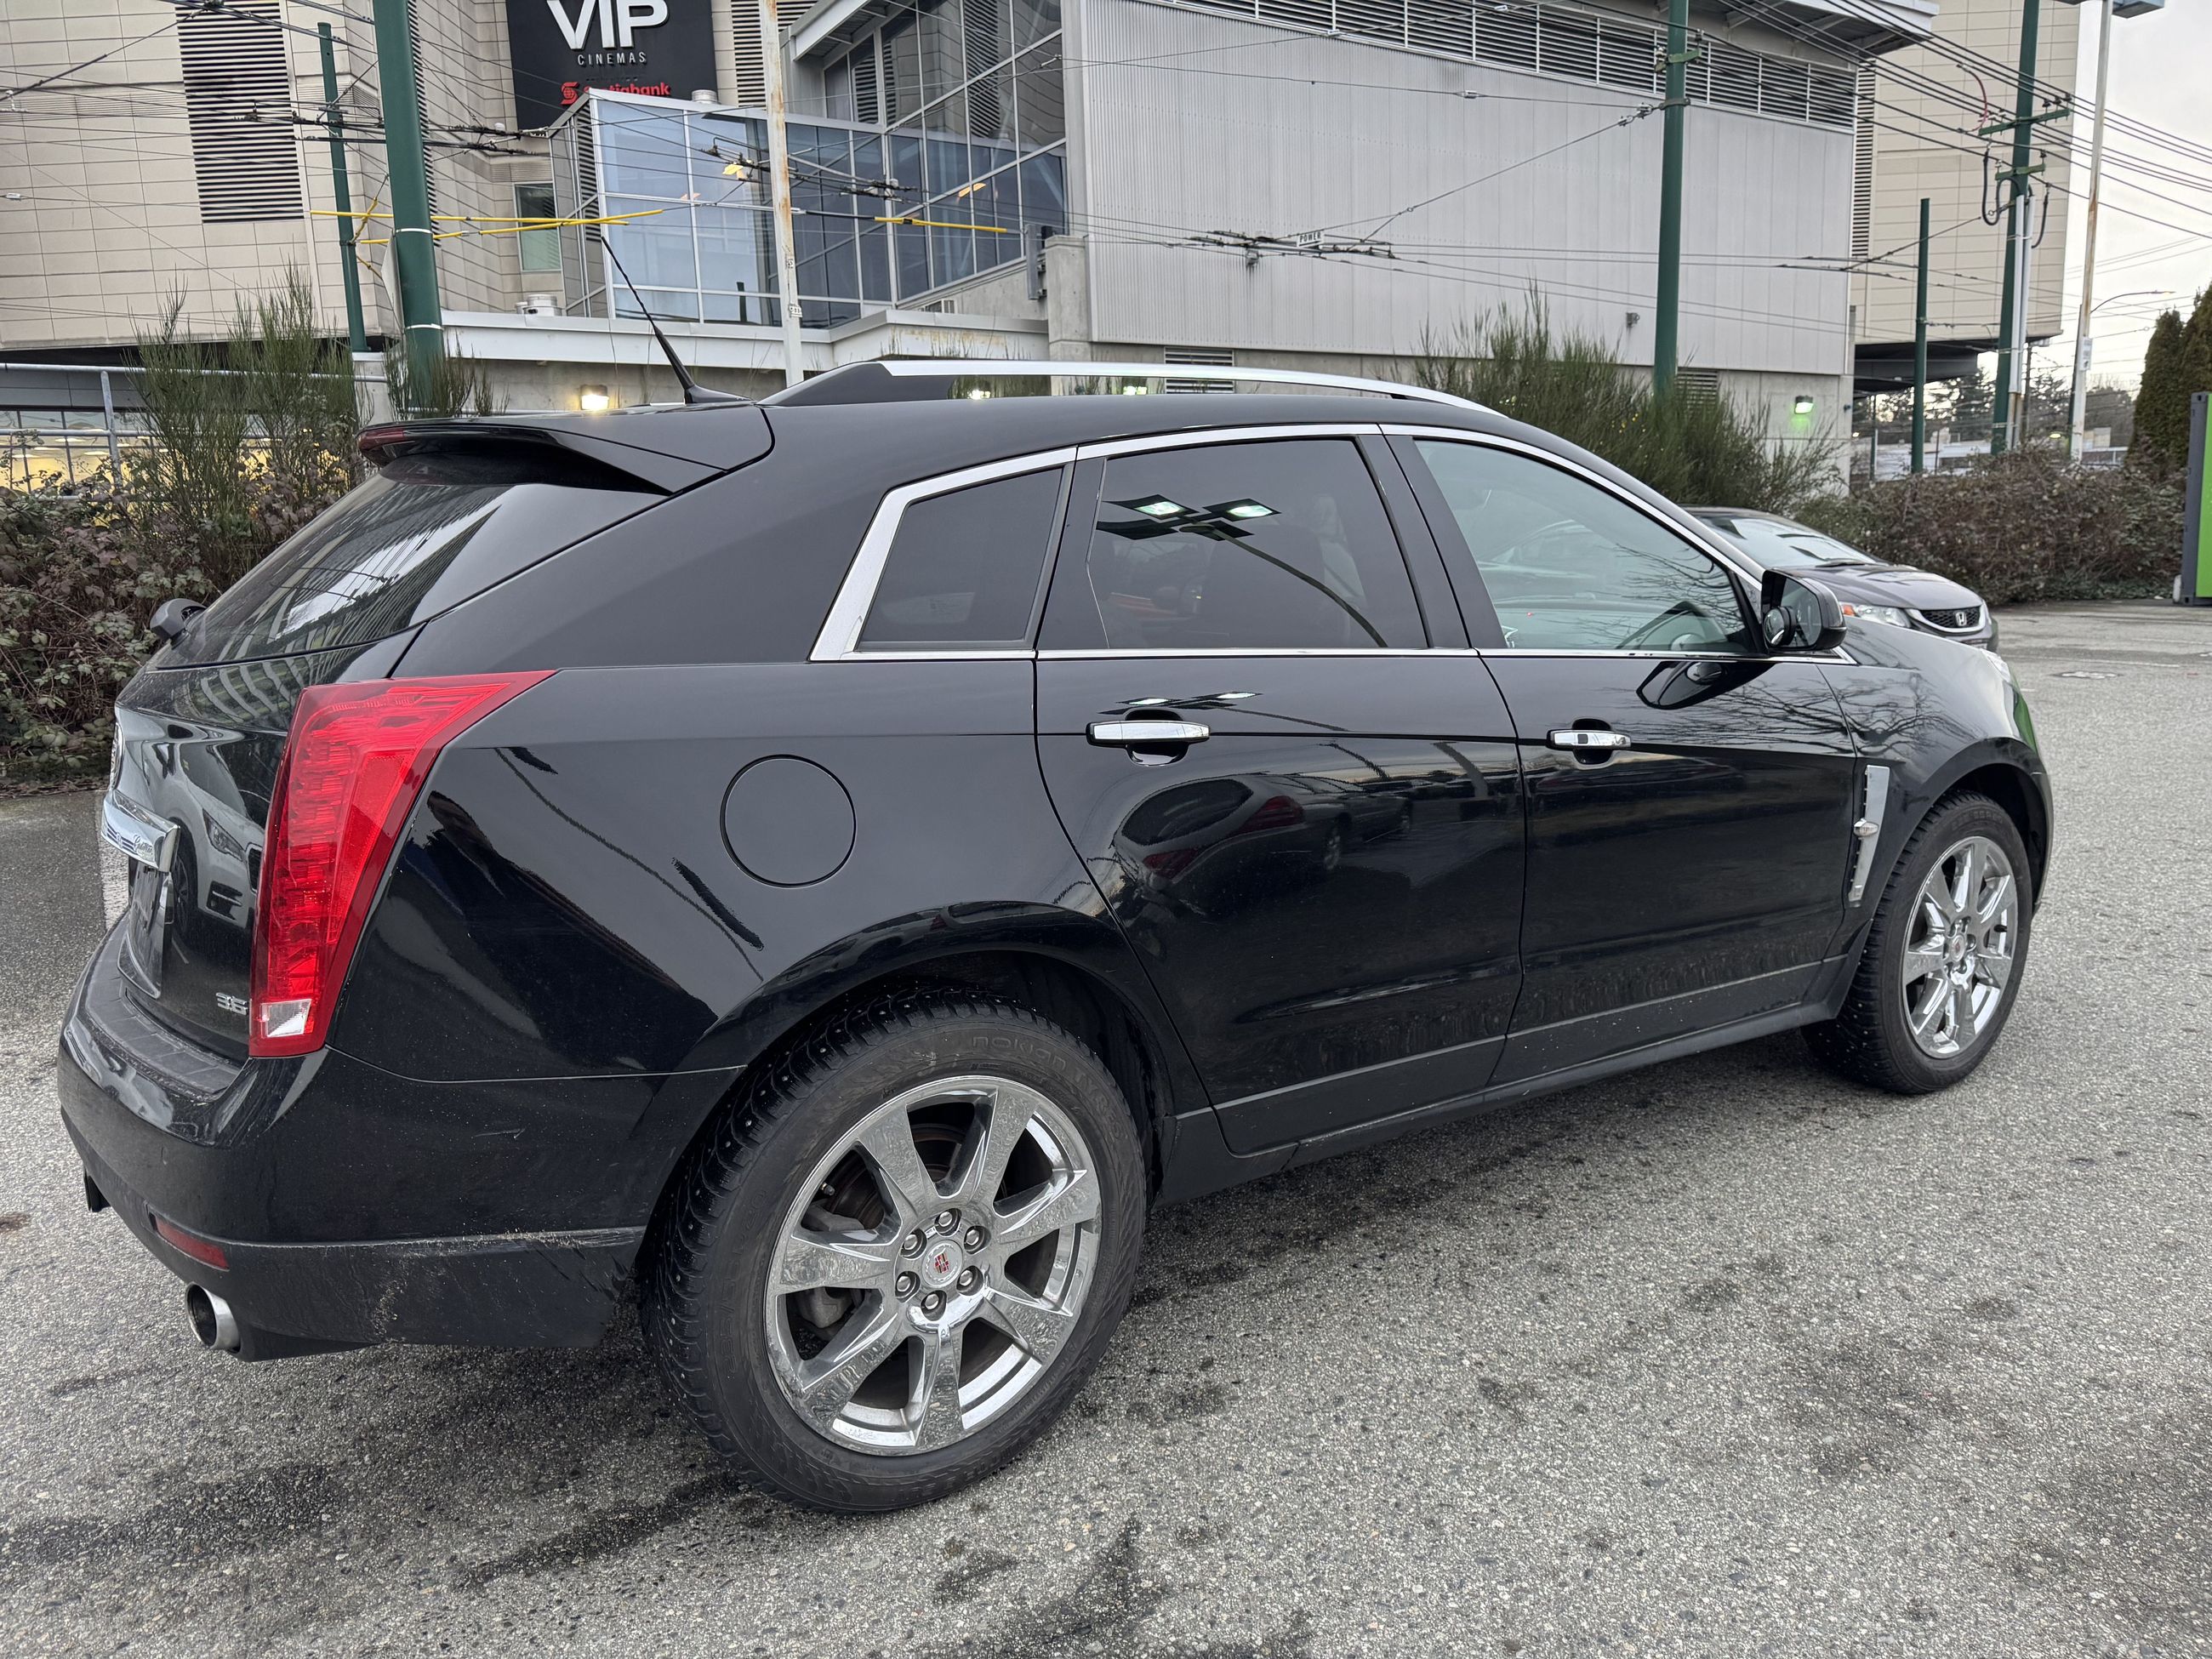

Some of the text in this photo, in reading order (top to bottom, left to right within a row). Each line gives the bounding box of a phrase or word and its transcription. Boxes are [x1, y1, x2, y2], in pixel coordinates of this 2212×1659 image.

[546, 0, 670, 50] VIP
[578, 52, 647, 66] CINEMAS
[1299, 231, 1321, 243] POWER
